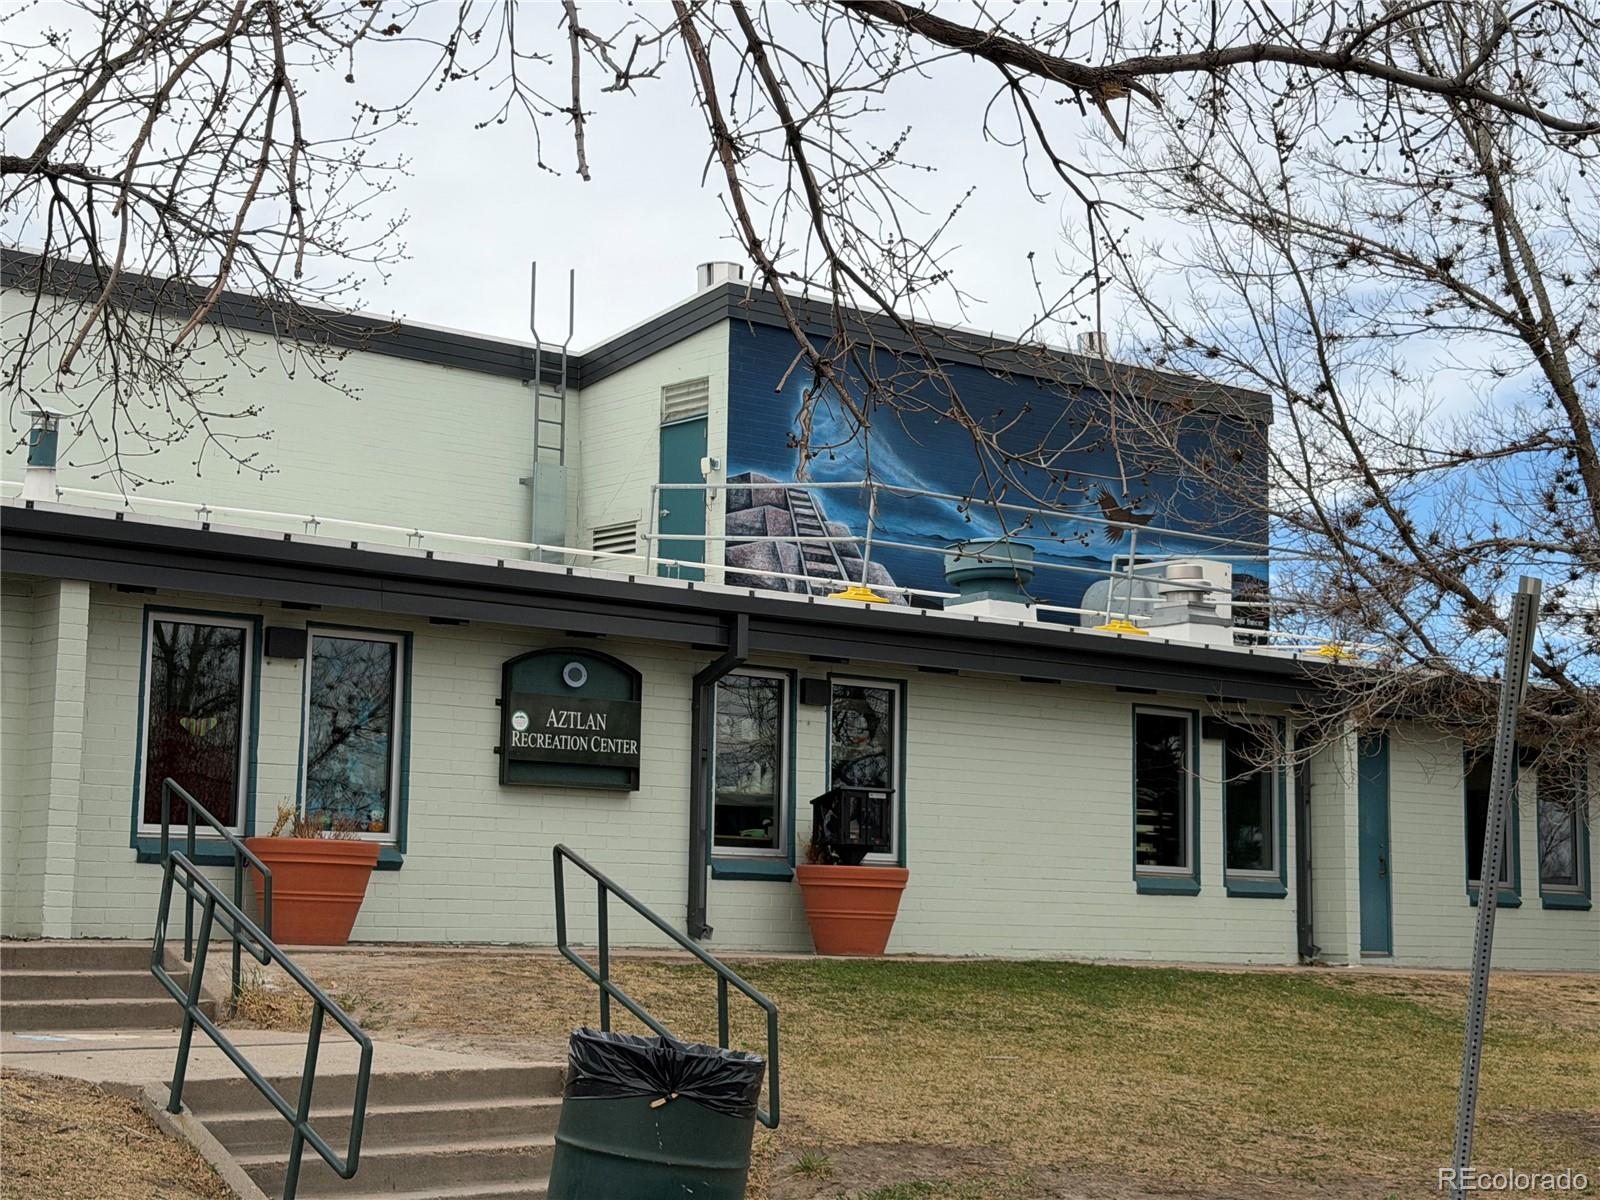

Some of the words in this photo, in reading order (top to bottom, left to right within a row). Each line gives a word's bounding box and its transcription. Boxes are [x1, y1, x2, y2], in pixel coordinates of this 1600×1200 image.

[546, 708, 607, 731] AZTLAN
[511, 730, 588, 751] RECREATION
[591, 735, 638, 755] CENTER
